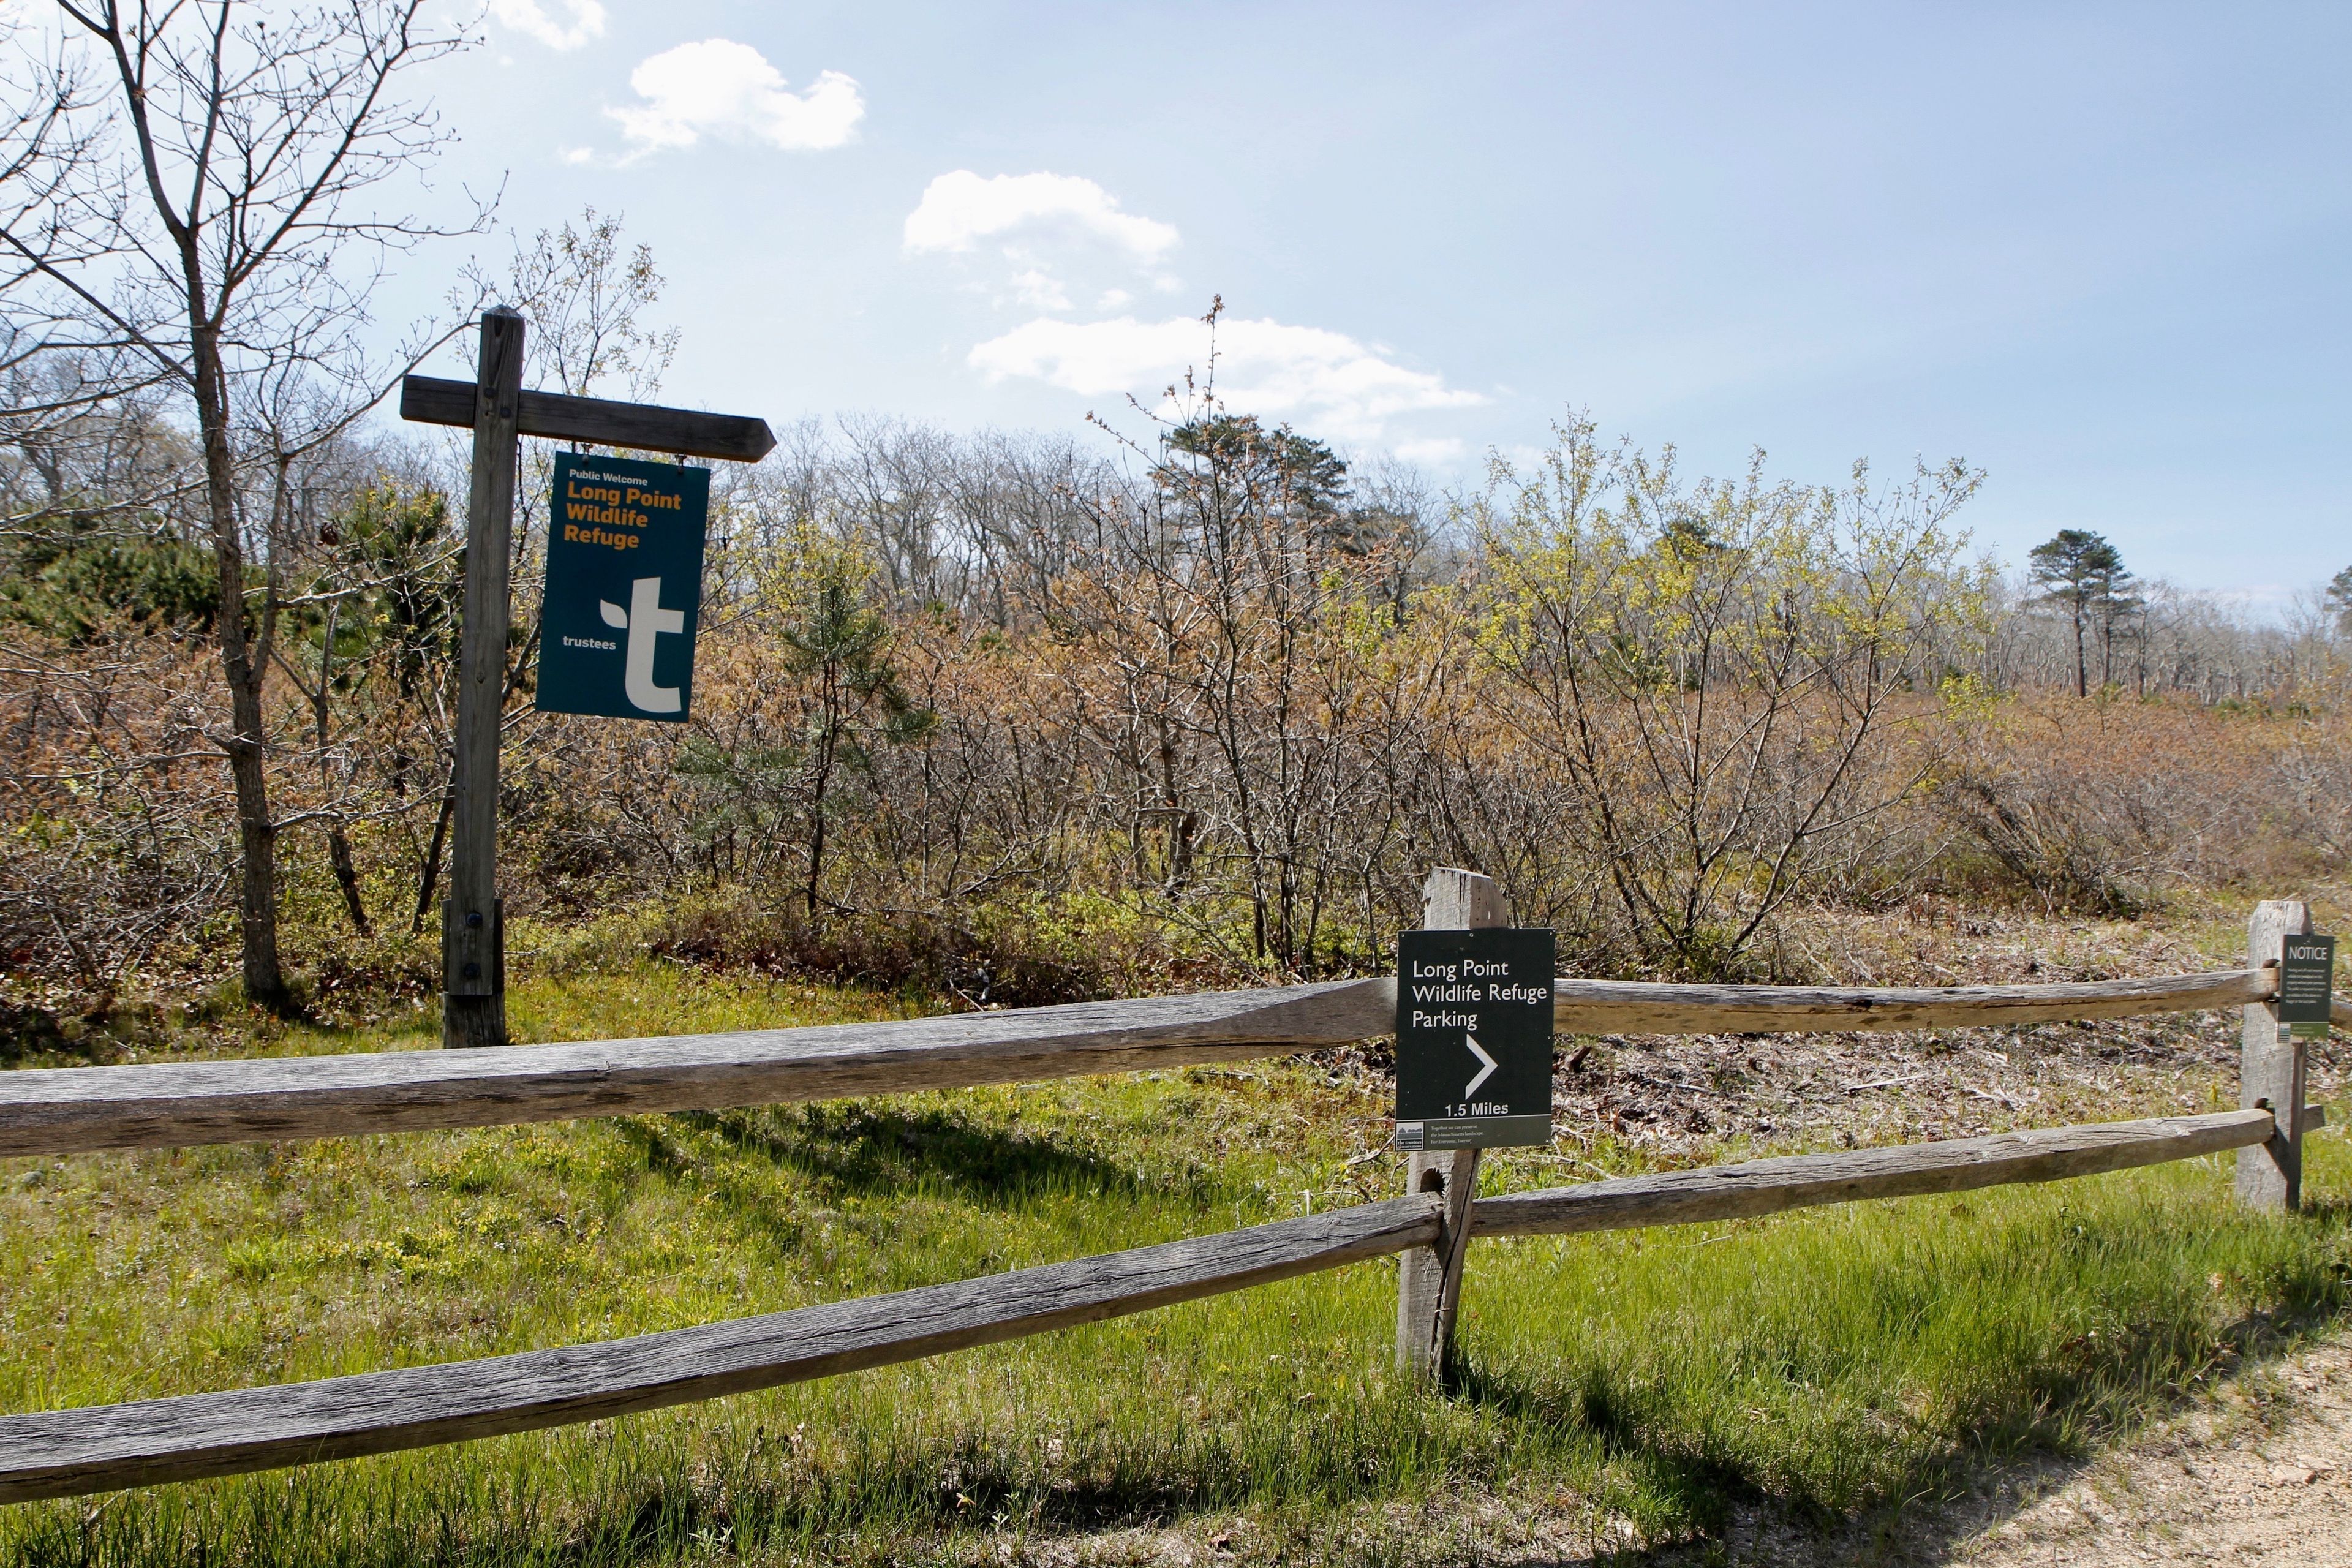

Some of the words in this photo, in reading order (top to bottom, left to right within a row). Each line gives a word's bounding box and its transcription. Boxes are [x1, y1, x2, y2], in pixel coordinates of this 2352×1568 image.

[569, 469, 600, 481] Public
[603, 472, 648, 486] Welcome
[568, 481, 620, 507] Long
[626, 488, 682, 510] Point
[566, 503, 649, 527] Wildlife
[564, 524, 639, 550] Refuge
[563, 636, 616, 650] trustees
[2288, 946, 2328, 960] NOTICE
[1413, 960, 1457, 982] Long
[1463, 959, 1509, 976] Point
[1412, 984, 1482, 1003] Wildlife
[1489, 983, 1547, 1005] Refuge
[1412, 1010, 1477, 1031] Parking
[1446, 1104, 1466, 1117] 1.5
[1471, 1102, 1509, 1116] Miles
